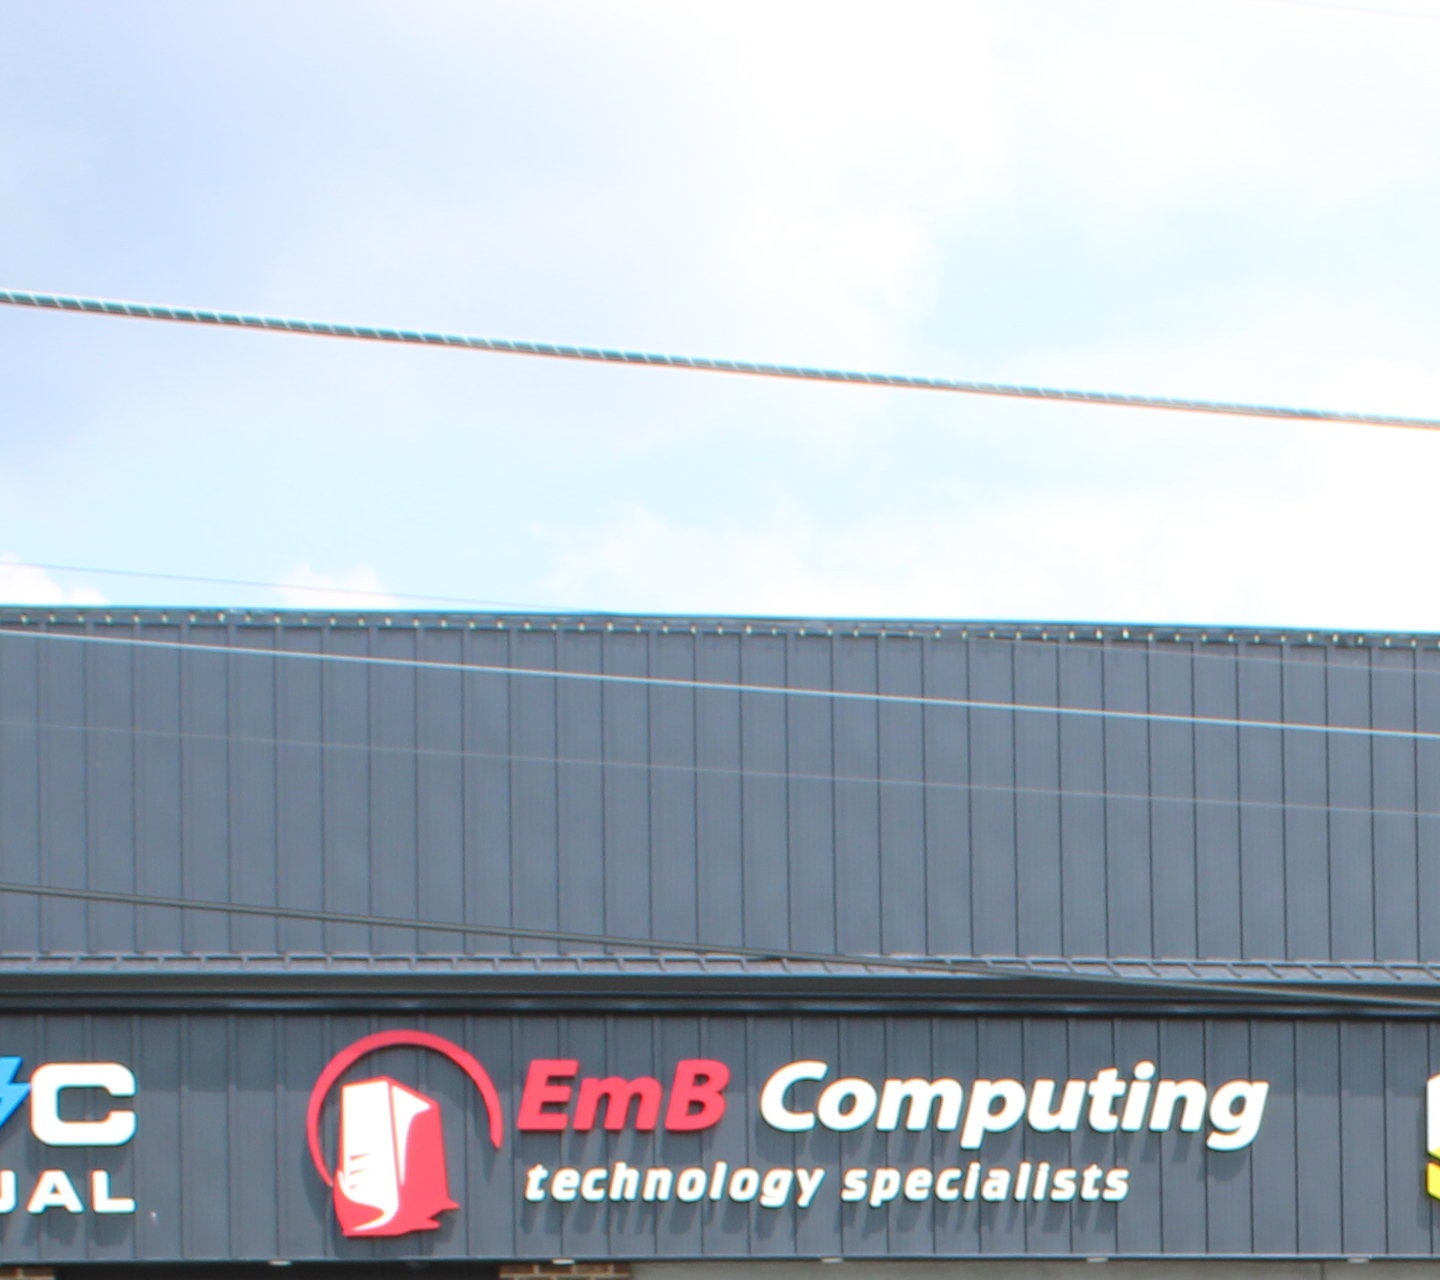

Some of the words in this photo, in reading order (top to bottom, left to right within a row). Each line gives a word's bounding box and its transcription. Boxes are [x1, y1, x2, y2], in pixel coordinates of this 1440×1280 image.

[516, 1059, 730, 1132] EmB
[760, 1060, 1269, 1150] Computing
[525, 1161, 820, 1209] technology
[841, 1161, 1129, 1209] specialists
